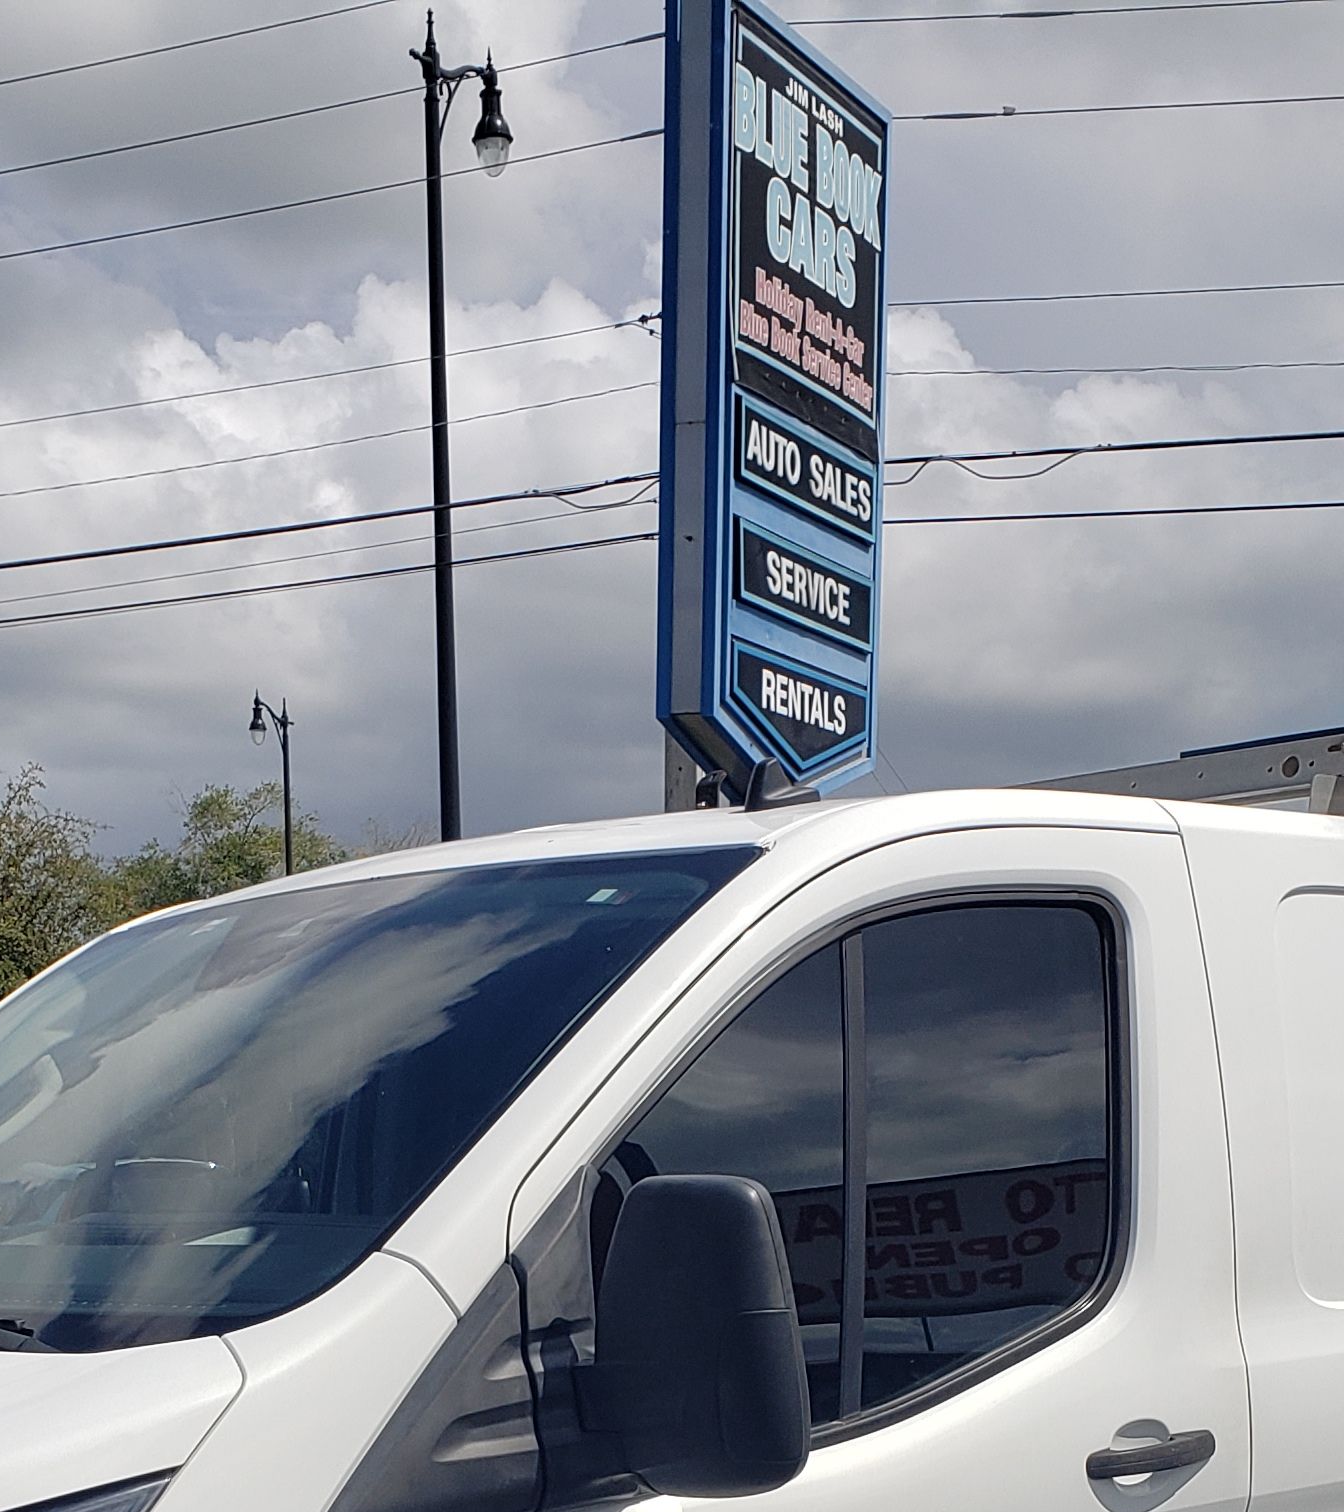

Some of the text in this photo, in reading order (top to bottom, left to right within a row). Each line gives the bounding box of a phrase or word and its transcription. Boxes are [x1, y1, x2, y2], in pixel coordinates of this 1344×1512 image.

[735, 61, 883, 252] BLUE BOOK
[786, 77, 844, 138] JIM LASH
[766, 176, 856, 309] CARS
[739, 298, 874, 412] Blue Book Service Center
[755, 266, 865, 368] Holiday Rent-A-Car
[746, 419, 872, 523] AUTO SALES
[766, 549, 851, 626] SERVICE
[761, 668, 846, 736] RENTALS
